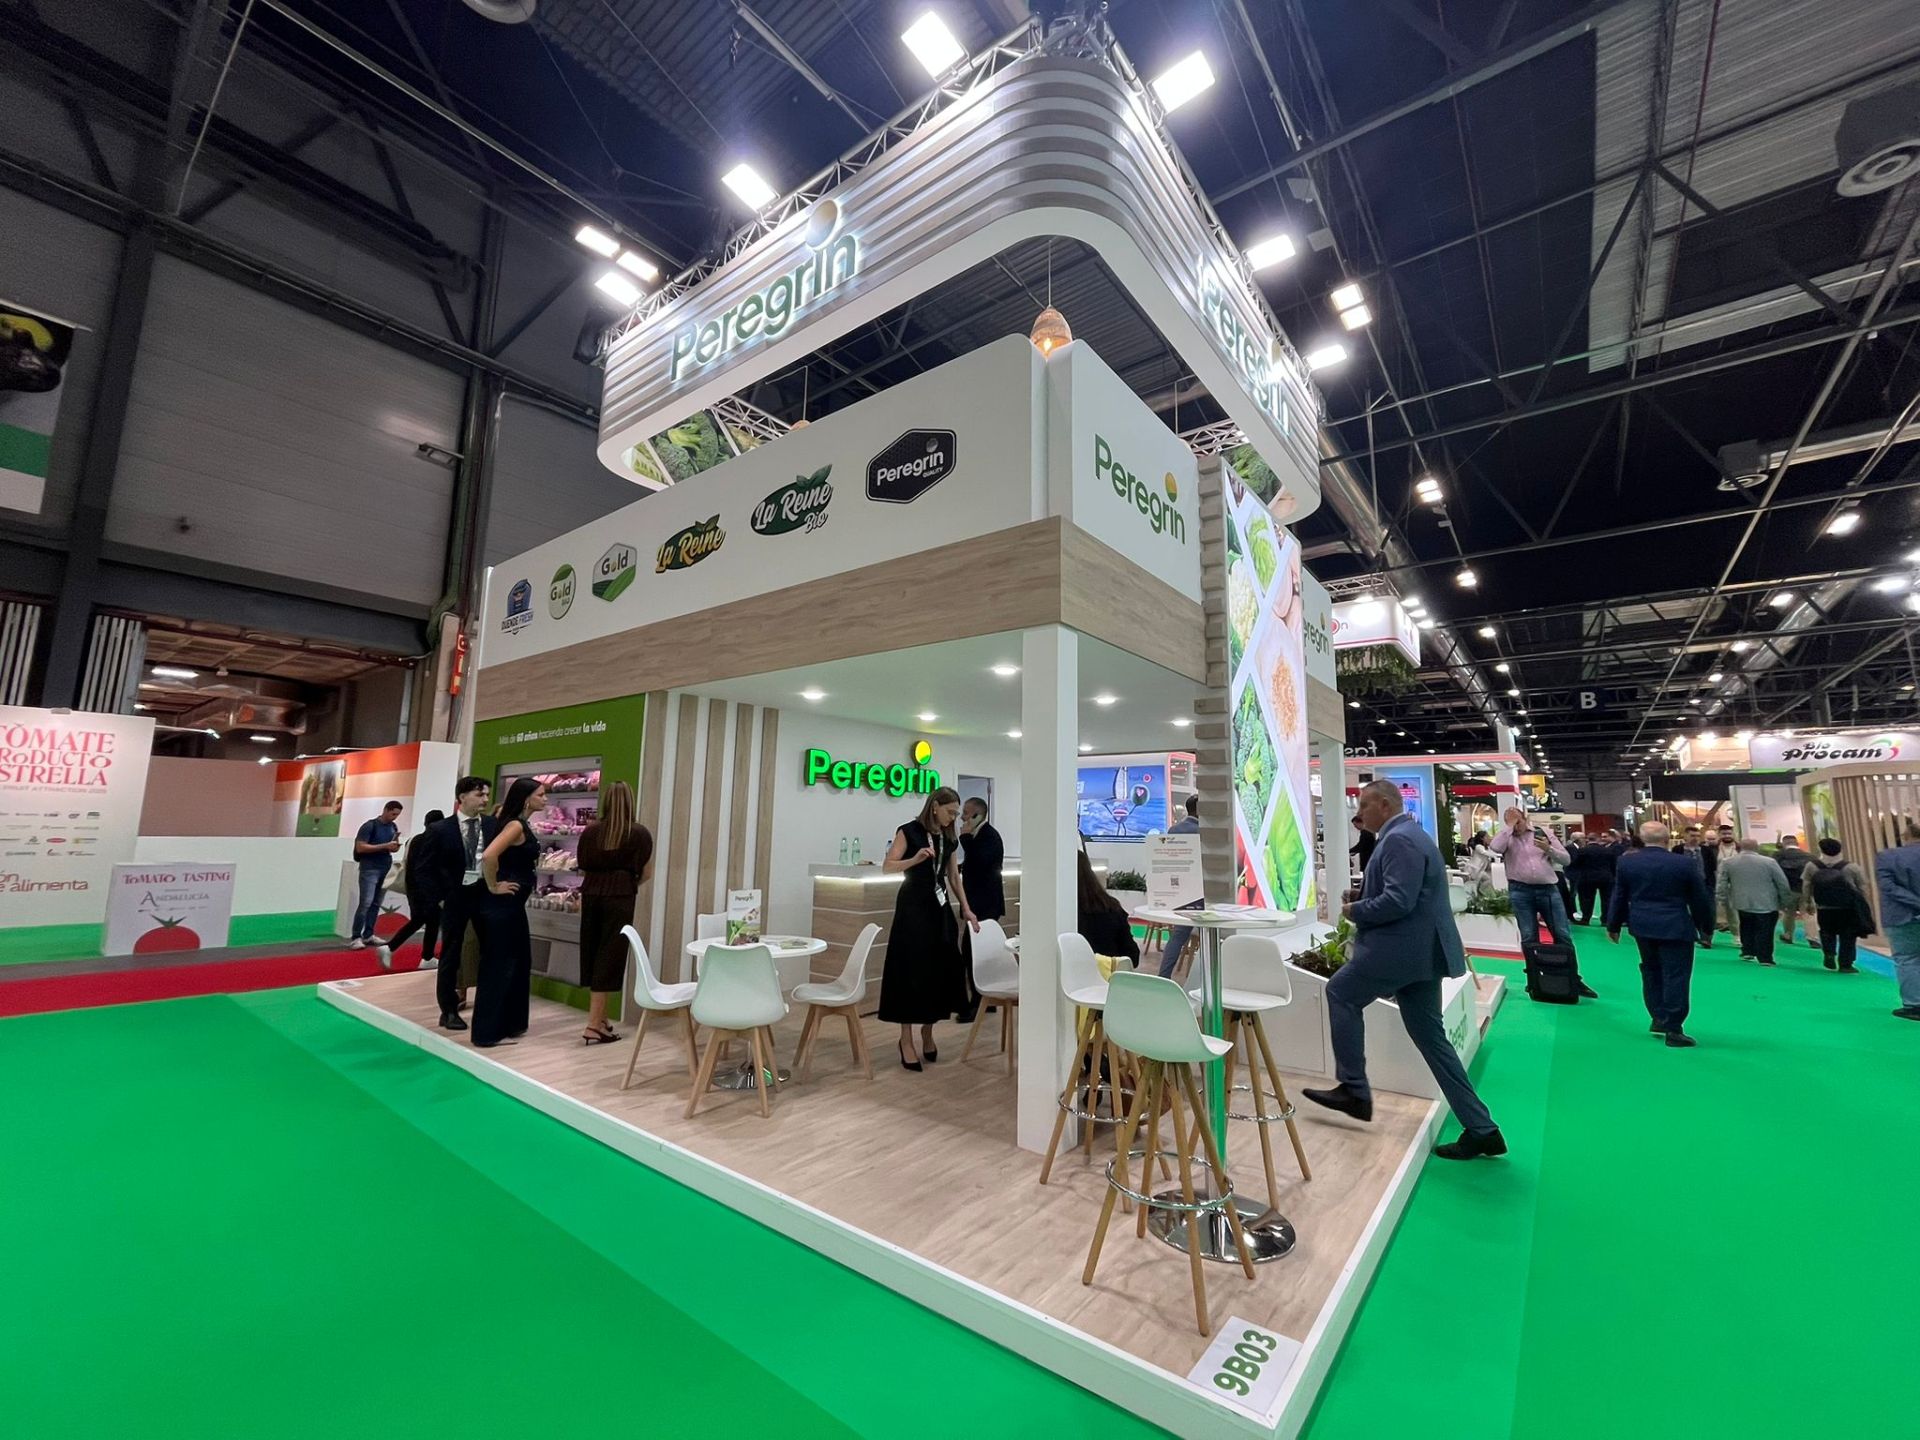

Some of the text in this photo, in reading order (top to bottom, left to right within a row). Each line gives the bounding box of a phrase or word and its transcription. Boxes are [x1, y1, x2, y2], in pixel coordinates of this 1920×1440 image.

[669, 199, 857, 382] Peregrin
[1199, 258, 1290, 436] Peregrin
[877, 438, 944, 487] Peregrin
[922, 466, 944, 478] QUALITY
[755, 481, 833, 530] La Reine
[1095, 433, 1186, 545] Peregrin
[804, 512, 828, 534] Bio
[655, 527, 726, 574] La Reine
[1303, 613, 1330, 656] eregrin
[1580, 692, 1598, 709] B
[590, 720, 607, 732] vida
[0, 747, 112, 769] RODUCTO
[0, 763, 108, 786] STRELLA
[803, 740, 941, 797] Peregrin
[10, 880, 88, 892] alimenta
[1213, 1330, 1277, 1396] 9B03
